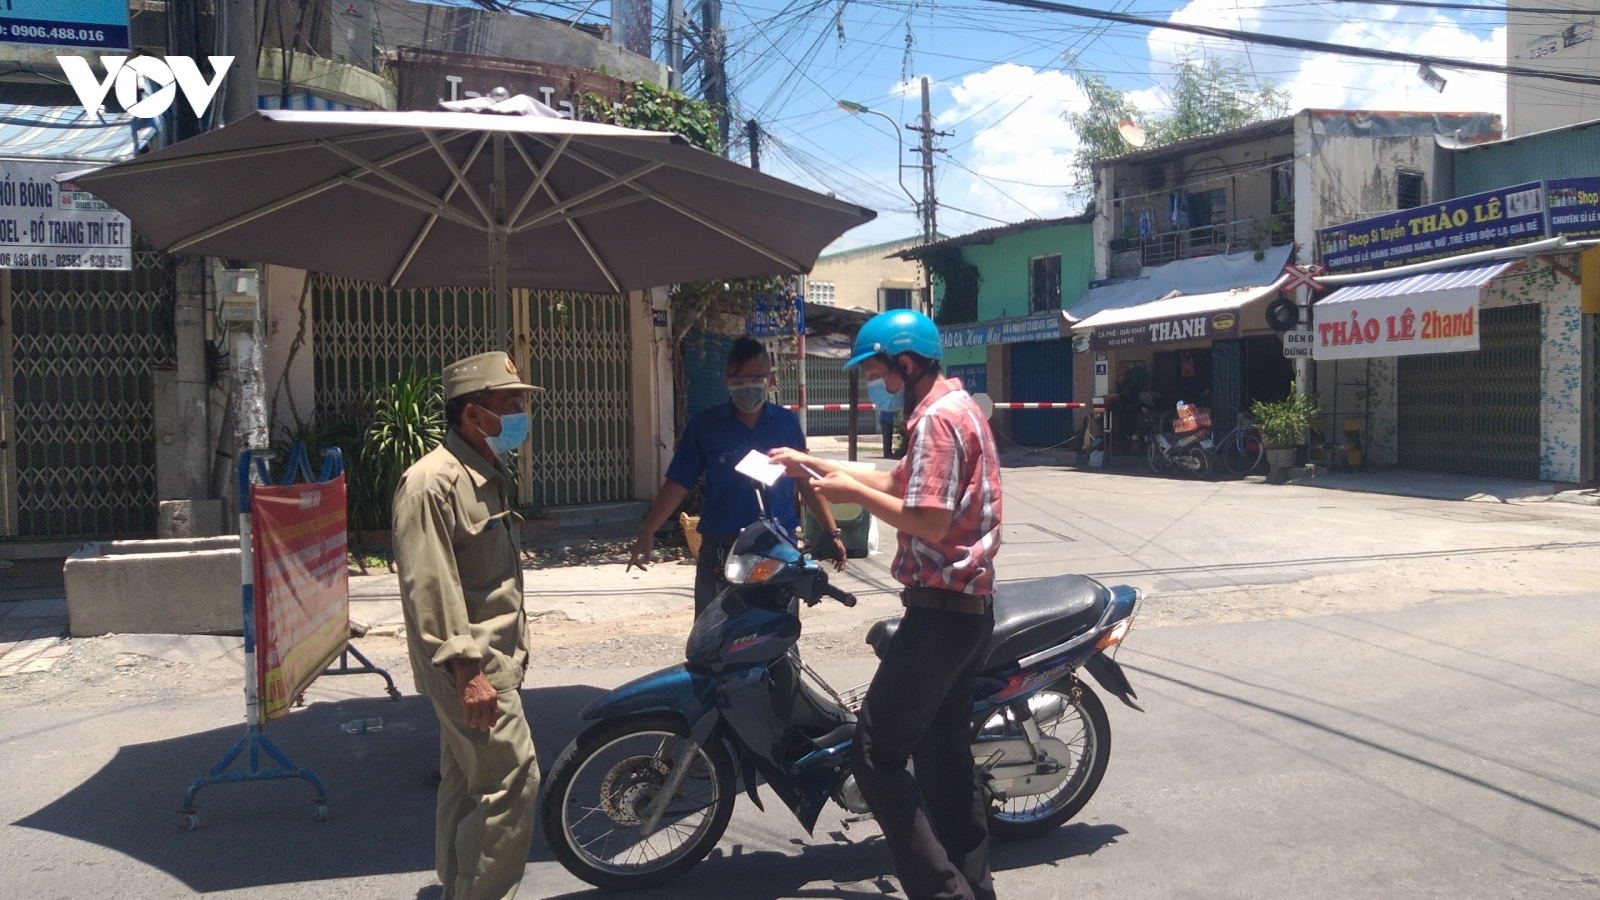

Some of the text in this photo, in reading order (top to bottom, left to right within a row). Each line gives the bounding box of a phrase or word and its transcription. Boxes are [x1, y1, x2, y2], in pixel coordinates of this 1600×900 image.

[11, 24, 104, 41] 0906.488.016
[20, 176, 52, 207] BÔNG
[1578, 190, 1599, 207] Shop
[48, 220, 84, 244] TRANG
[86, 217, 104, 244] TRÍ
[106, 214, 124, 245] TẾT
[1348, 233, 1370, 248] Shop
[1408, 205, 1469, 236] THẢO
[1473, 196, 1503, 224] LÊ
[13, 253, 29, 266] 488
[31, 253, 48, 266] 016
[1149, 317, 1206, 342] THANH
[1288, 333, 1306, 343] ĐÈN
[1318, 306, 1475, 347] THẢO LÊ 2hand
